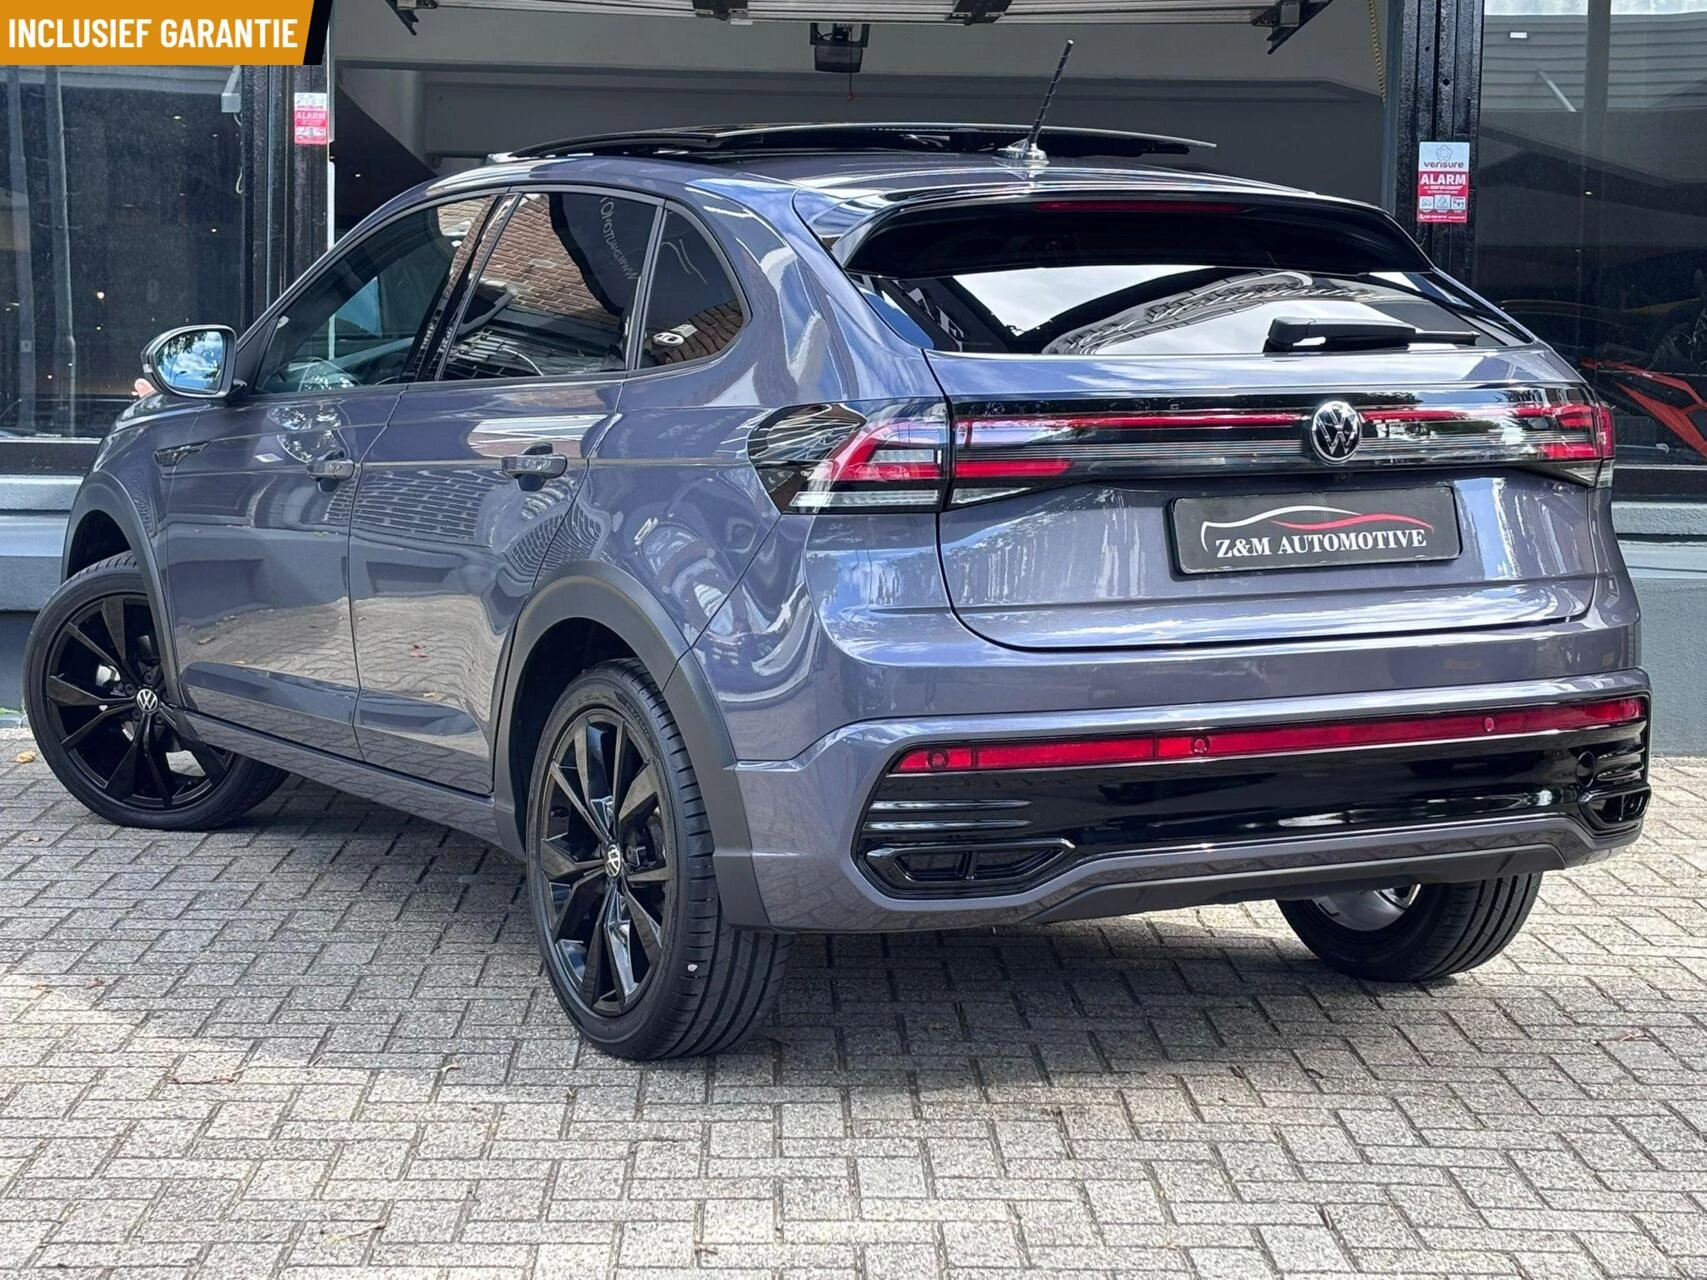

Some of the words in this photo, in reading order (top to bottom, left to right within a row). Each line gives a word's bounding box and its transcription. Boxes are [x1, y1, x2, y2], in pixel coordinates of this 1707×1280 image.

[1423, 161, 1464, 169] verisure
[1420, 173, 1466, 185] ALARM
[1215, 537, 1271, 558] Z&M
[1277, 529, 1427, 554] AUTOMOTIVE
